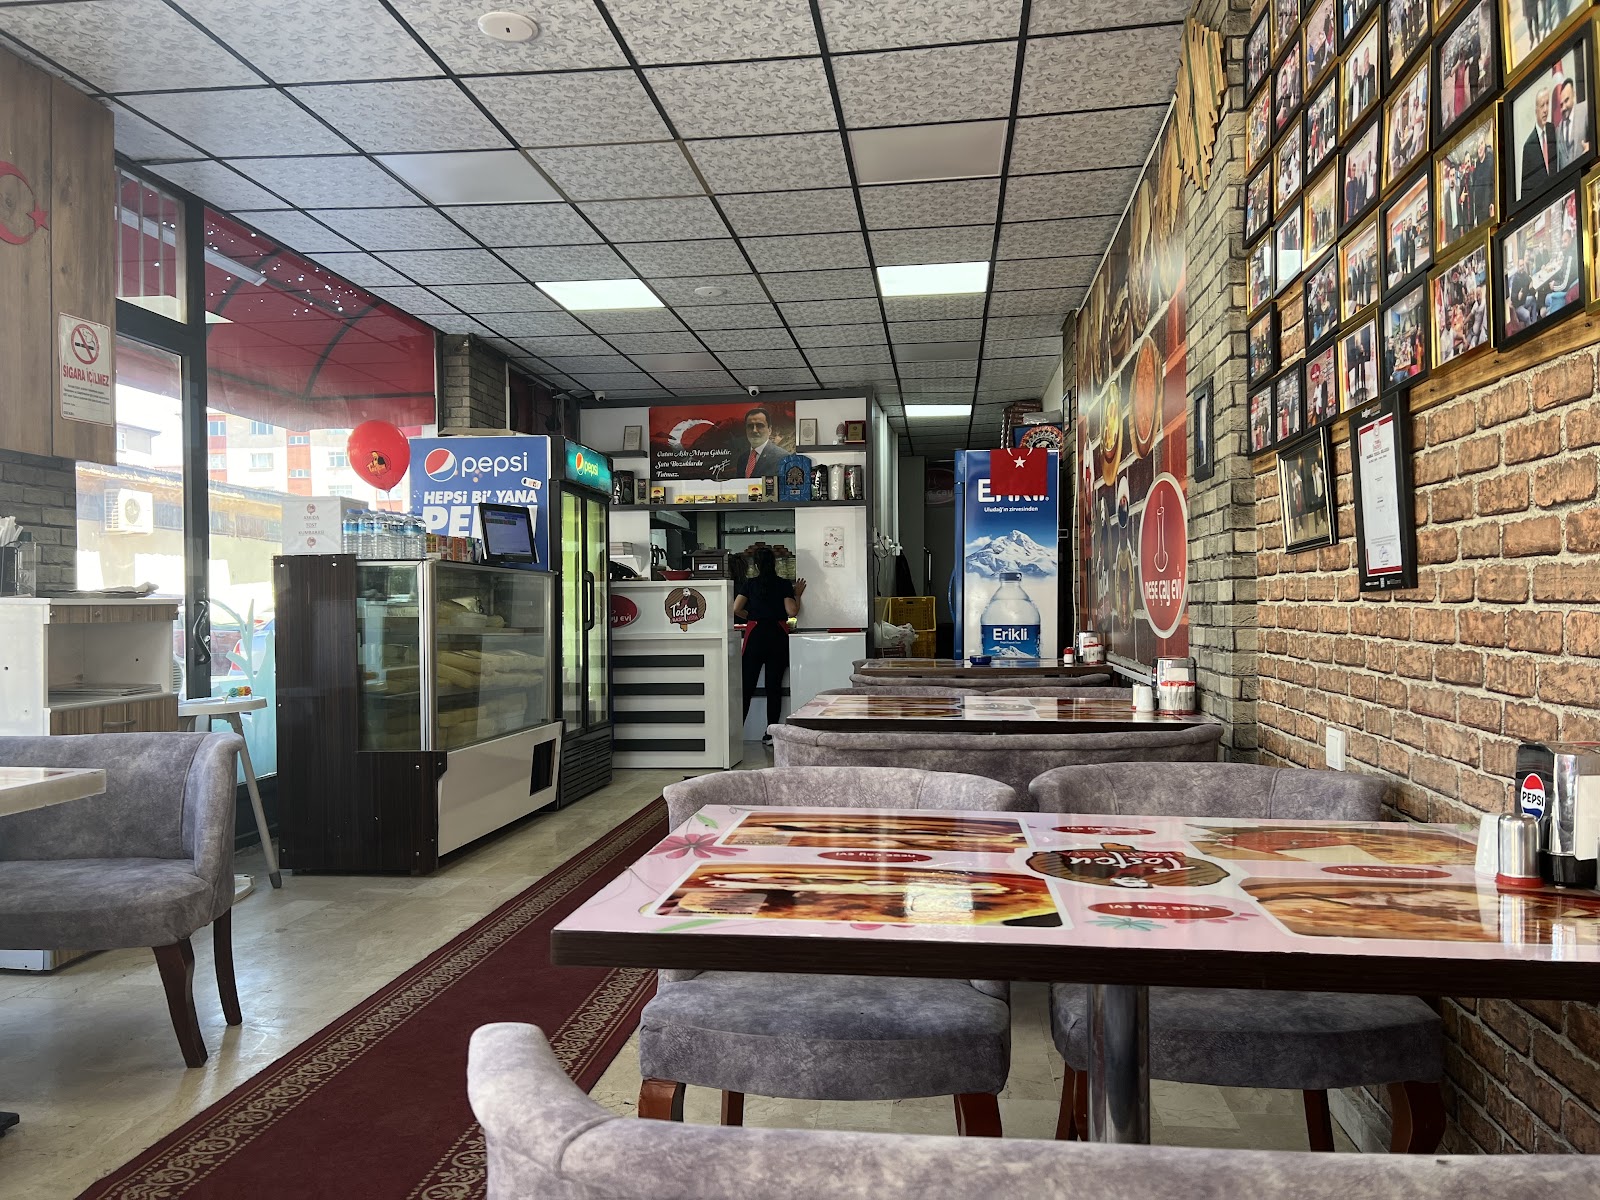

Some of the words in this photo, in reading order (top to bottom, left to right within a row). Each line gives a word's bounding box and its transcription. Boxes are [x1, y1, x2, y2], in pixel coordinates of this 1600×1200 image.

[63, 363, 86, 381] SİGARA
[86, 367, 110, 387] İÇİLMEZ
[461, 451, 529, 478] pepsi
[584, 461, 599, 477] pepsi
[424, 490, 467, 504] HEPSi
[496, 490, 538, 503] YANA
[1171, 571, 1182, 600] evi
[620, 613, 632, 622] evi
[993, 627, 1028, 641] Erikli
[1522, 791, 1544, 807] PEPSI
